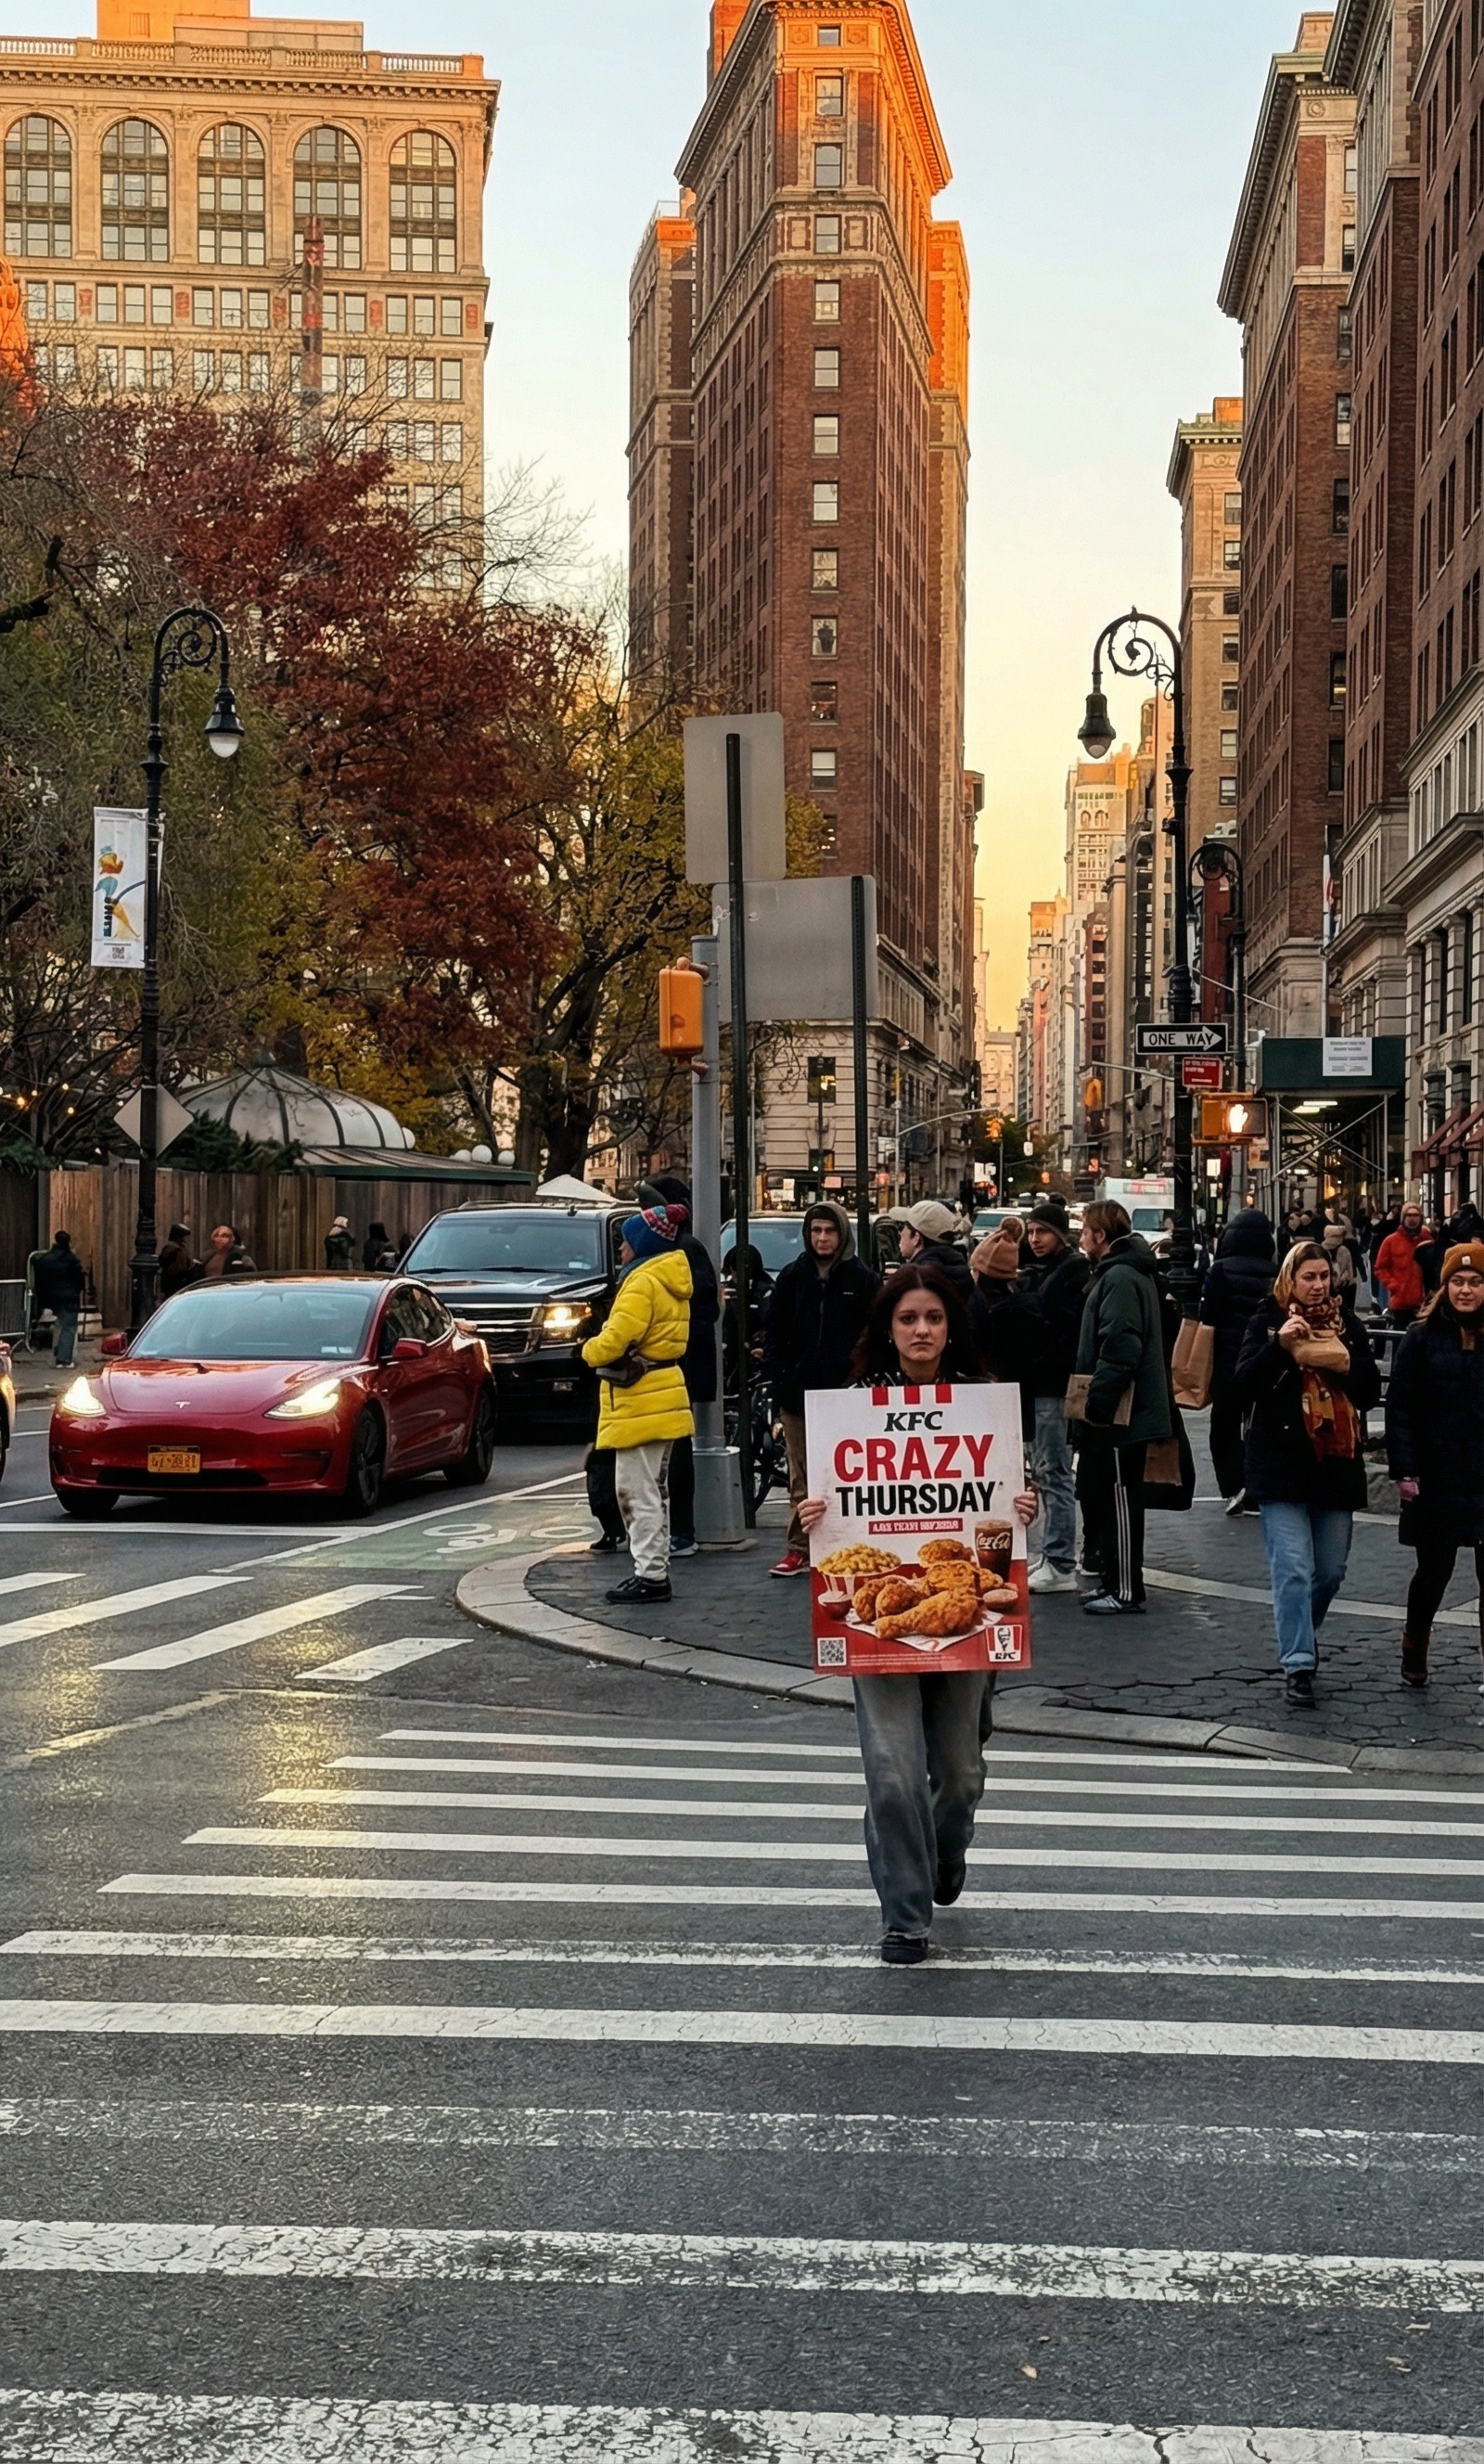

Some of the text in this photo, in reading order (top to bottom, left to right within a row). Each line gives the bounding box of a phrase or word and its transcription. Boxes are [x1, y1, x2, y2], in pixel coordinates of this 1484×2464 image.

[1149, 1033, 1213, 1046] ONE WAY
[884, 1411, 943, 1431] KFC
[834, 1434, 994, 1482] CRAZY
[836, 1481, 996, 1517] THURSDAY
